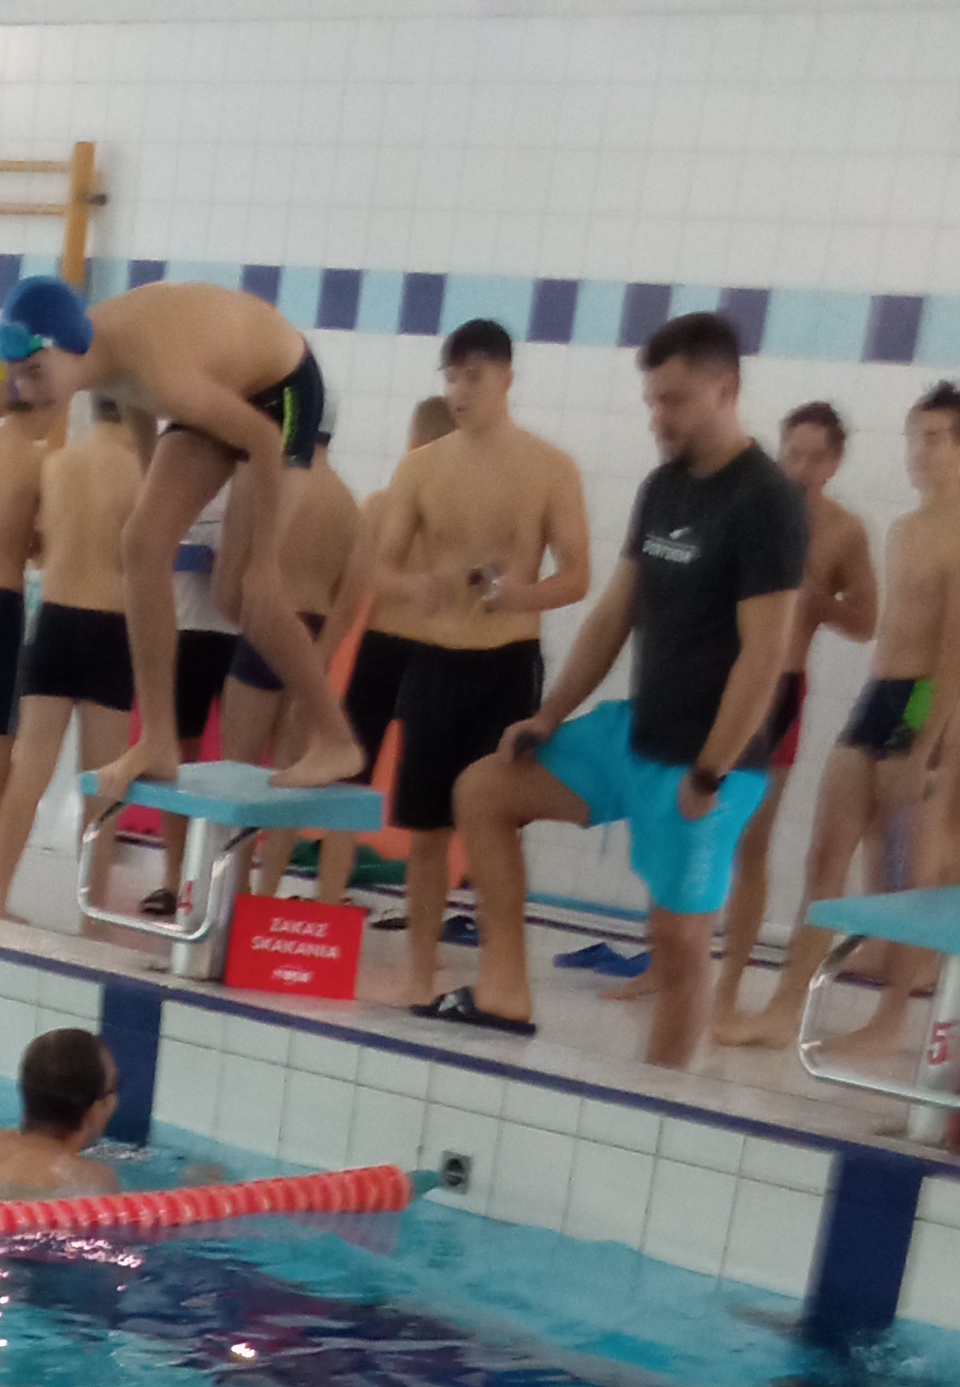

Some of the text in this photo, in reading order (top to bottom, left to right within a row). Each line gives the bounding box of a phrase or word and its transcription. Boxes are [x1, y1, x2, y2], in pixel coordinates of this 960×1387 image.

[269, 917, 329, 938] ZAKAZ
[251, 934, 340, 960] SKAKANIA
[928, 1021, 952, 1067] 5
